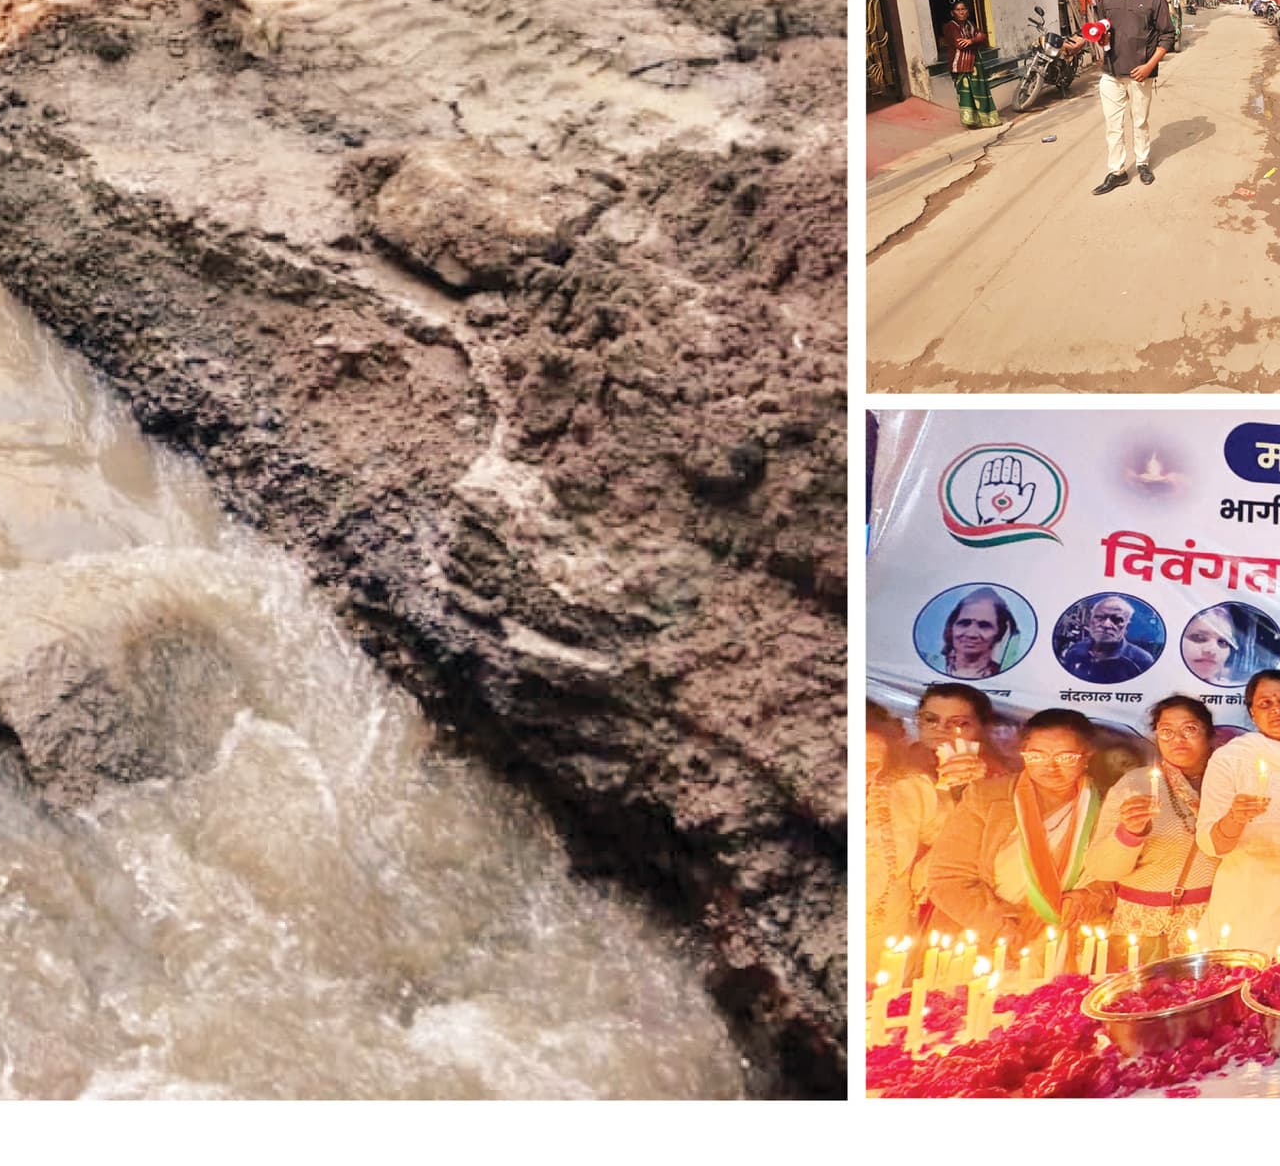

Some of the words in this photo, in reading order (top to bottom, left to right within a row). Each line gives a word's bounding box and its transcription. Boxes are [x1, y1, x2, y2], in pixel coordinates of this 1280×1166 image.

[1101, 531, 1280, 593] दिवंगत
[1060, 688, 1112, 703] नंदलाल
[1114, 691, 1144, 704] पाल
